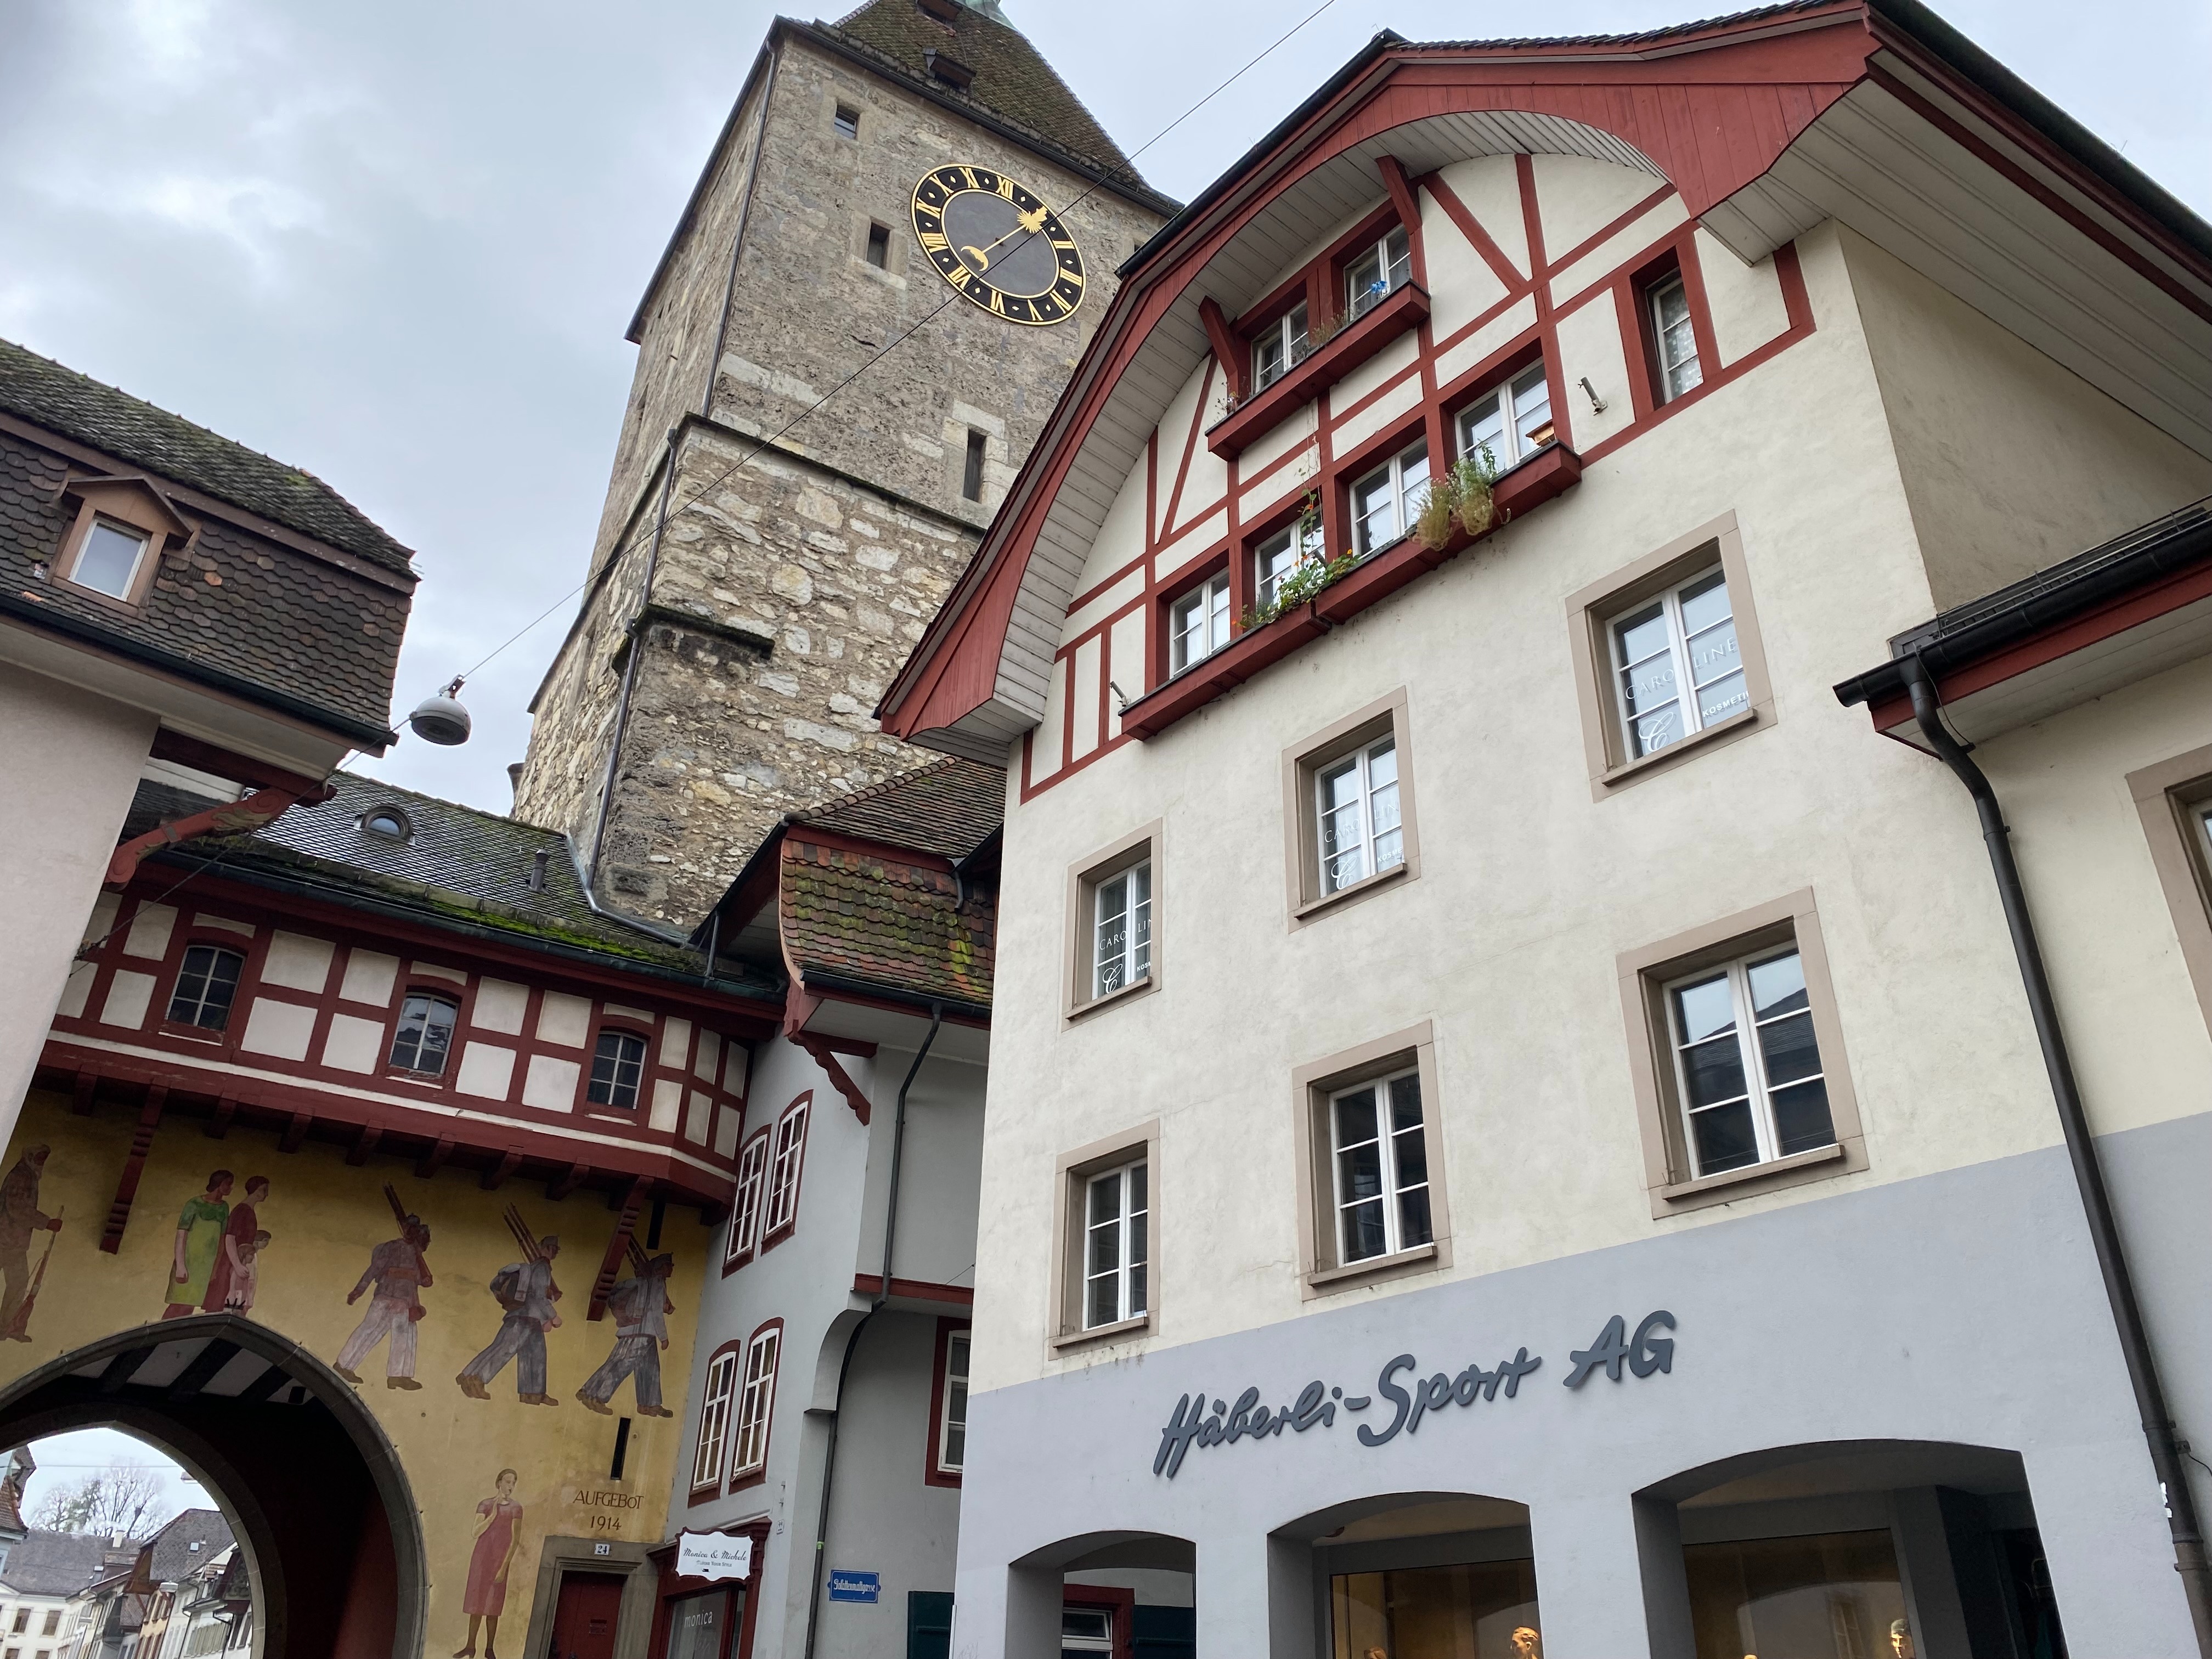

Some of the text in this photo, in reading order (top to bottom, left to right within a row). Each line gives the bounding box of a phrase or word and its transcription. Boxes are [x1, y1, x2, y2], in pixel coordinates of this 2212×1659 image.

[929, 173, 954, 196] X
[996, 176, 1014, 200] XII
[921, 233, 949, 253] VIII
[948, 265, 972, 289] VII
[990, 289, 1006, 314] VI
[1028, 299, 1043, 321] V
[1049, 289, 1073, 314] IV
[1153, 1310, 1675, 1478] Häberli-Sport AG
[573, 1490, 645, 1509] AUFGEBOT
[590, 1516, 622, 1531] 1914
[597, 1545, 607, 1554] 24
[683, 1548, 747, 1561] Monica & Michele
[684, 1609, 713, 1629] monica
